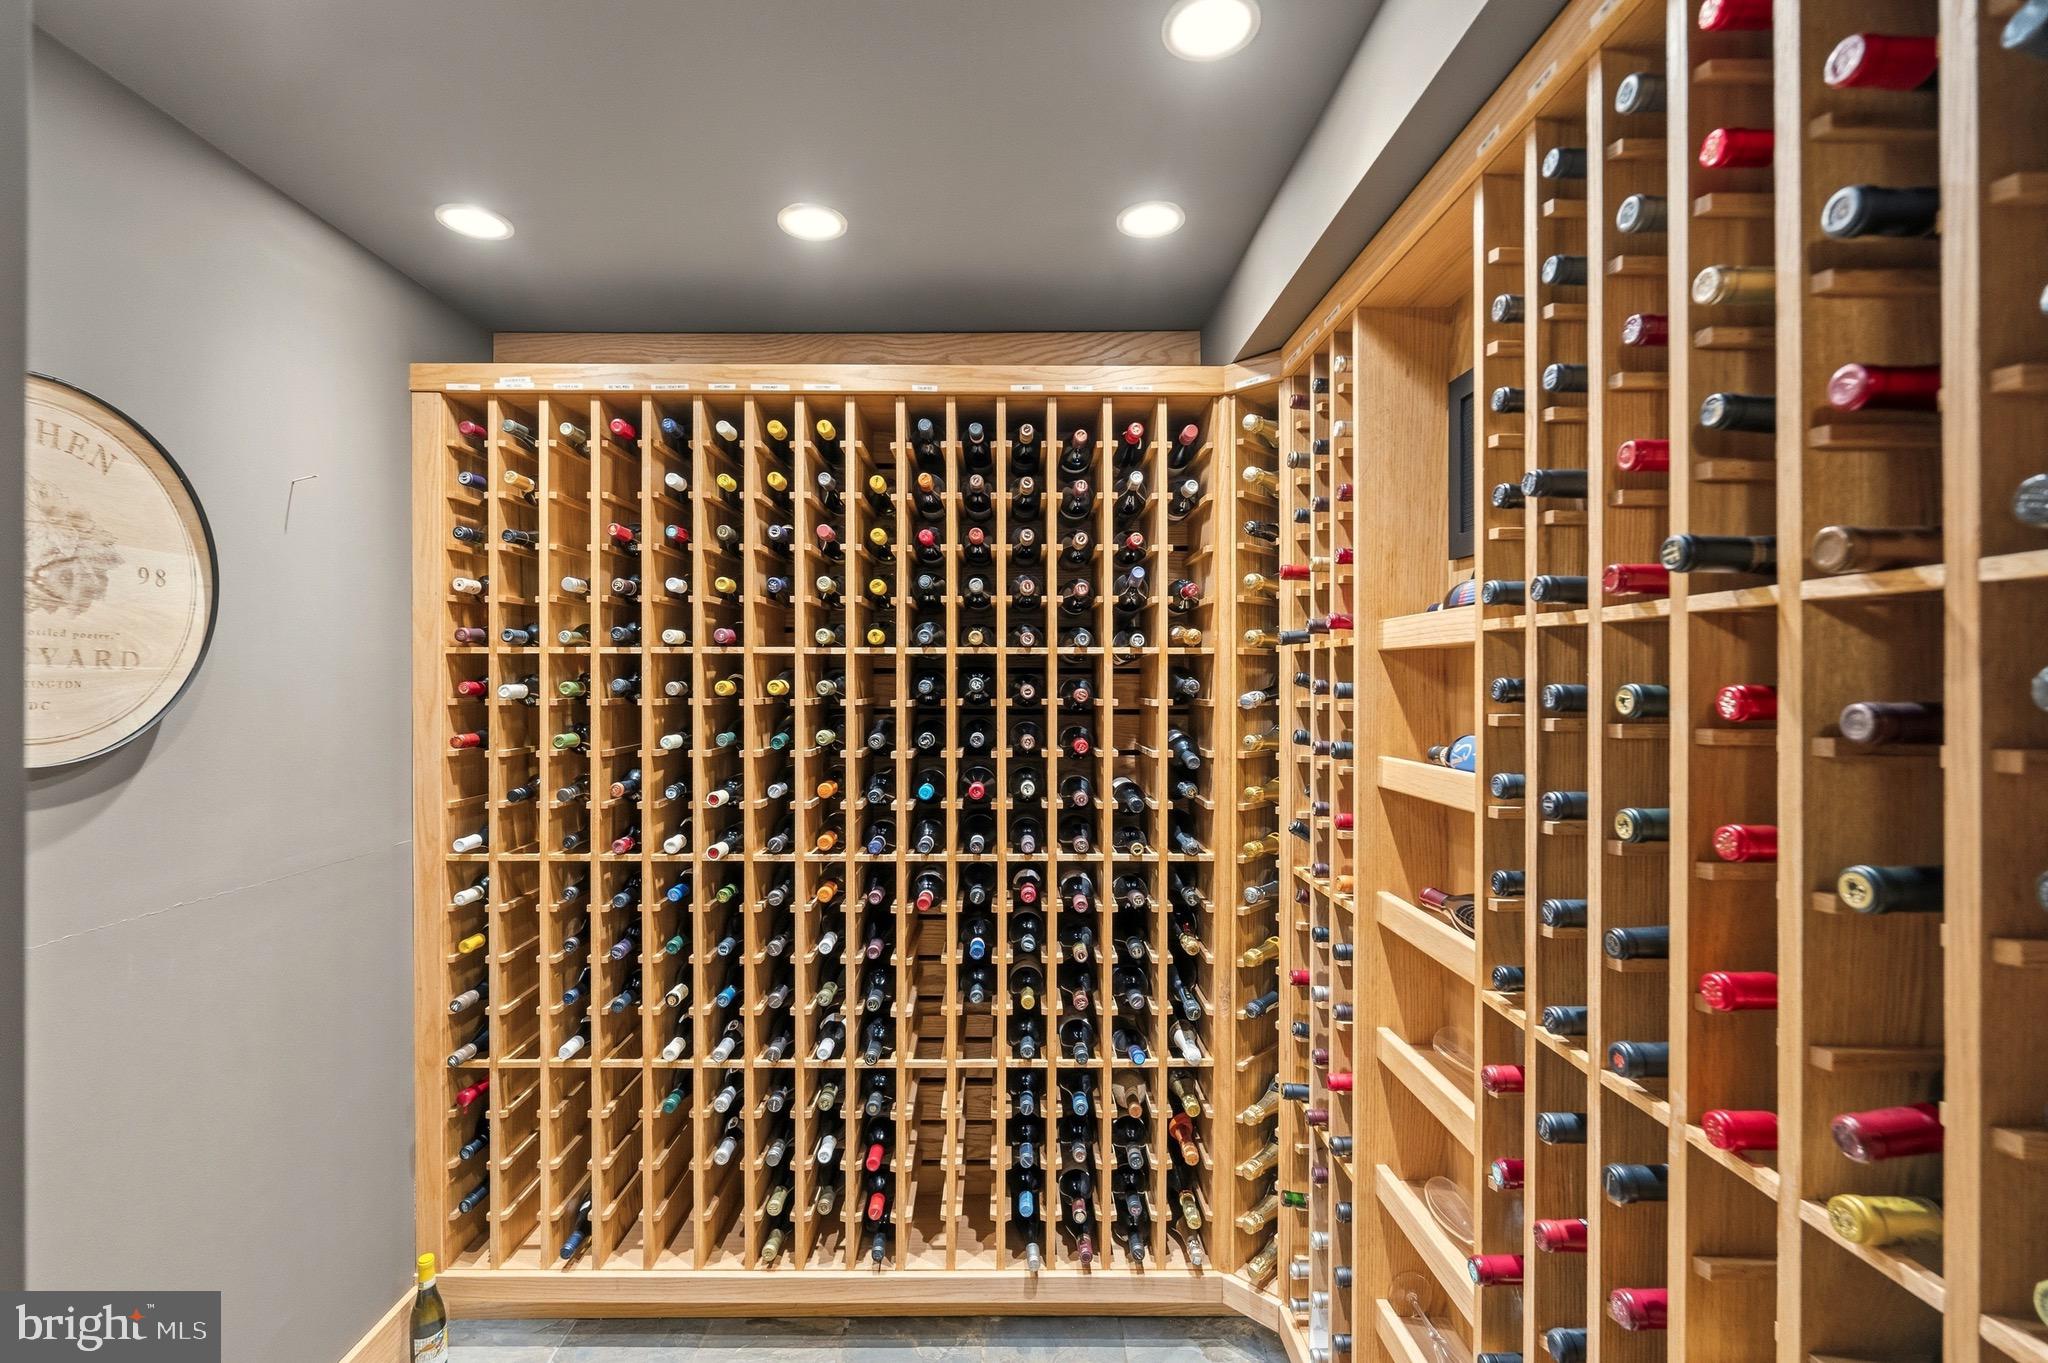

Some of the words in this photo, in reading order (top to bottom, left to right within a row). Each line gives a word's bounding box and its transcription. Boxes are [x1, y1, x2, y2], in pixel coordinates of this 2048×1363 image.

[137, 566, 167, 588] 98
[24, 647, 141, 670] YARD
[28, 701, 51, 711] DC
